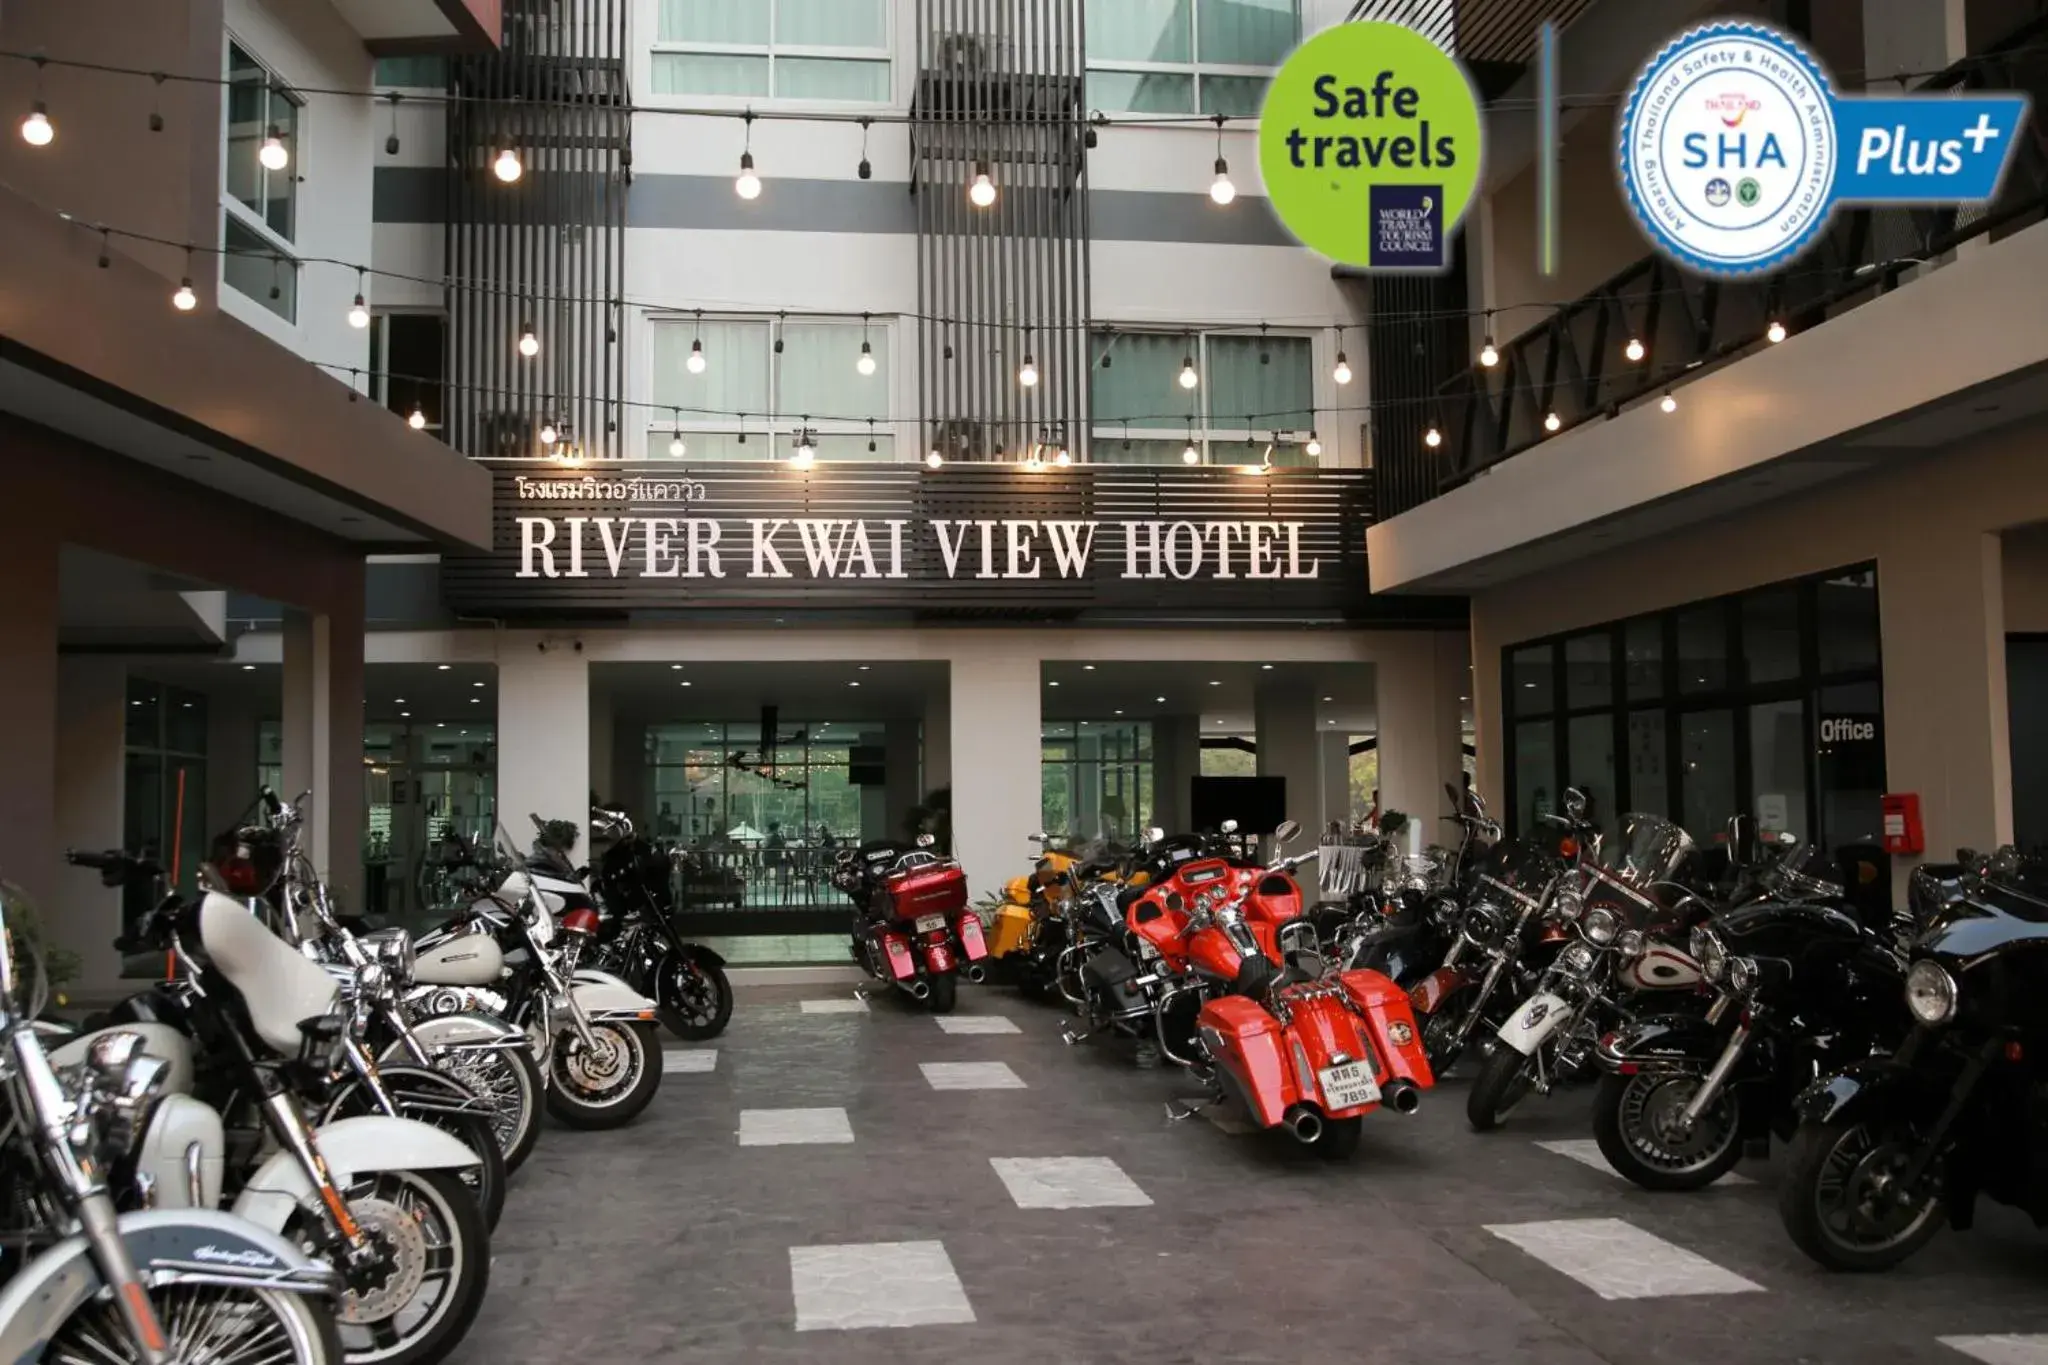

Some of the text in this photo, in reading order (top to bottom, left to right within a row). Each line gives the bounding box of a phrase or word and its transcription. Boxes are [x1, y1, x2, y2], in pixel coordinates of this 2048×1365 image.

[515, 517, 1319, 580] RIVER KWAI VIEW HOTEL
[1820, 718, 1875, 742] Office
[1340, 1088, 1369, 1104] 789
